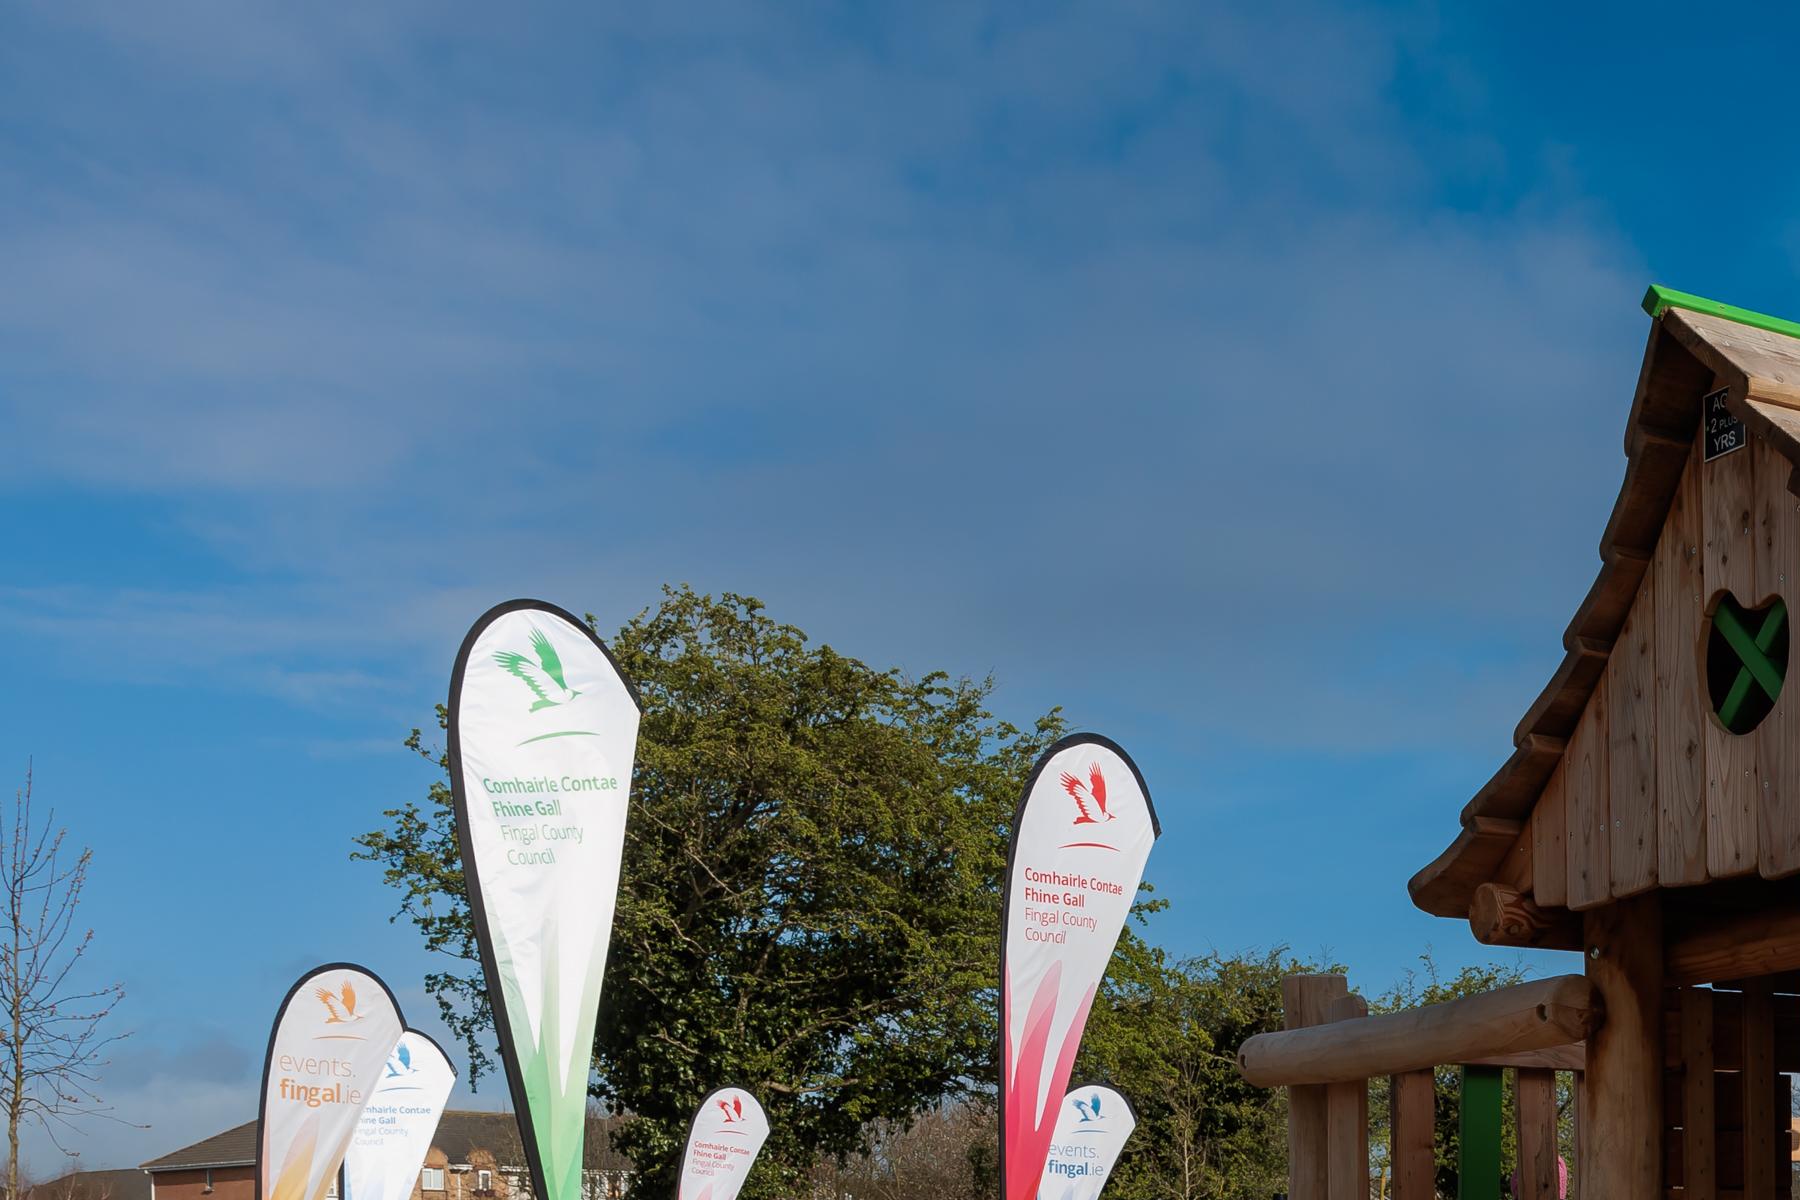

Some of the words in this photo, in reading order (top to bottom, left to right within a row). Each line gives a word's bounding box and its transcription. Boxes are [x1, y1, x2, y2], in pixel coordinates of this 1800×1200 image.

[1711, 418, 1717, 433] 2
[1713, 430, 1736, 452] YRS
[483, 776, 559, 794] Comhairle
[561, 776, 618, 792] Contae
[492, 801, 535, 817] Fhine
[535, 800, 562, 816] Gall
[500, 824, 540, 846] Fingal
[541, 824, 584, 845] County
[507, 848, 556, 866] Council
[1025, 867, 1088, 889] Comhairle
[1090, 878, 1123, 896] Contae
[1025, 887, 1060, 905] Fhine
[1063, 893, 1085, 908] Gall
[1025, 907, 1059, 927] Fingal
[1062, 911, 1098, 933] County
[1025, 927, 1067, 945] Council
[279, 1054, 357, 1079] events.
[279, 1077, 361, 1109] fingal.ie
[399, 1106, 432, 1114] Contae
[378, 1117, 396, 1125] Gall
[1048, 1159, 1104, 1179] fingal.ie
